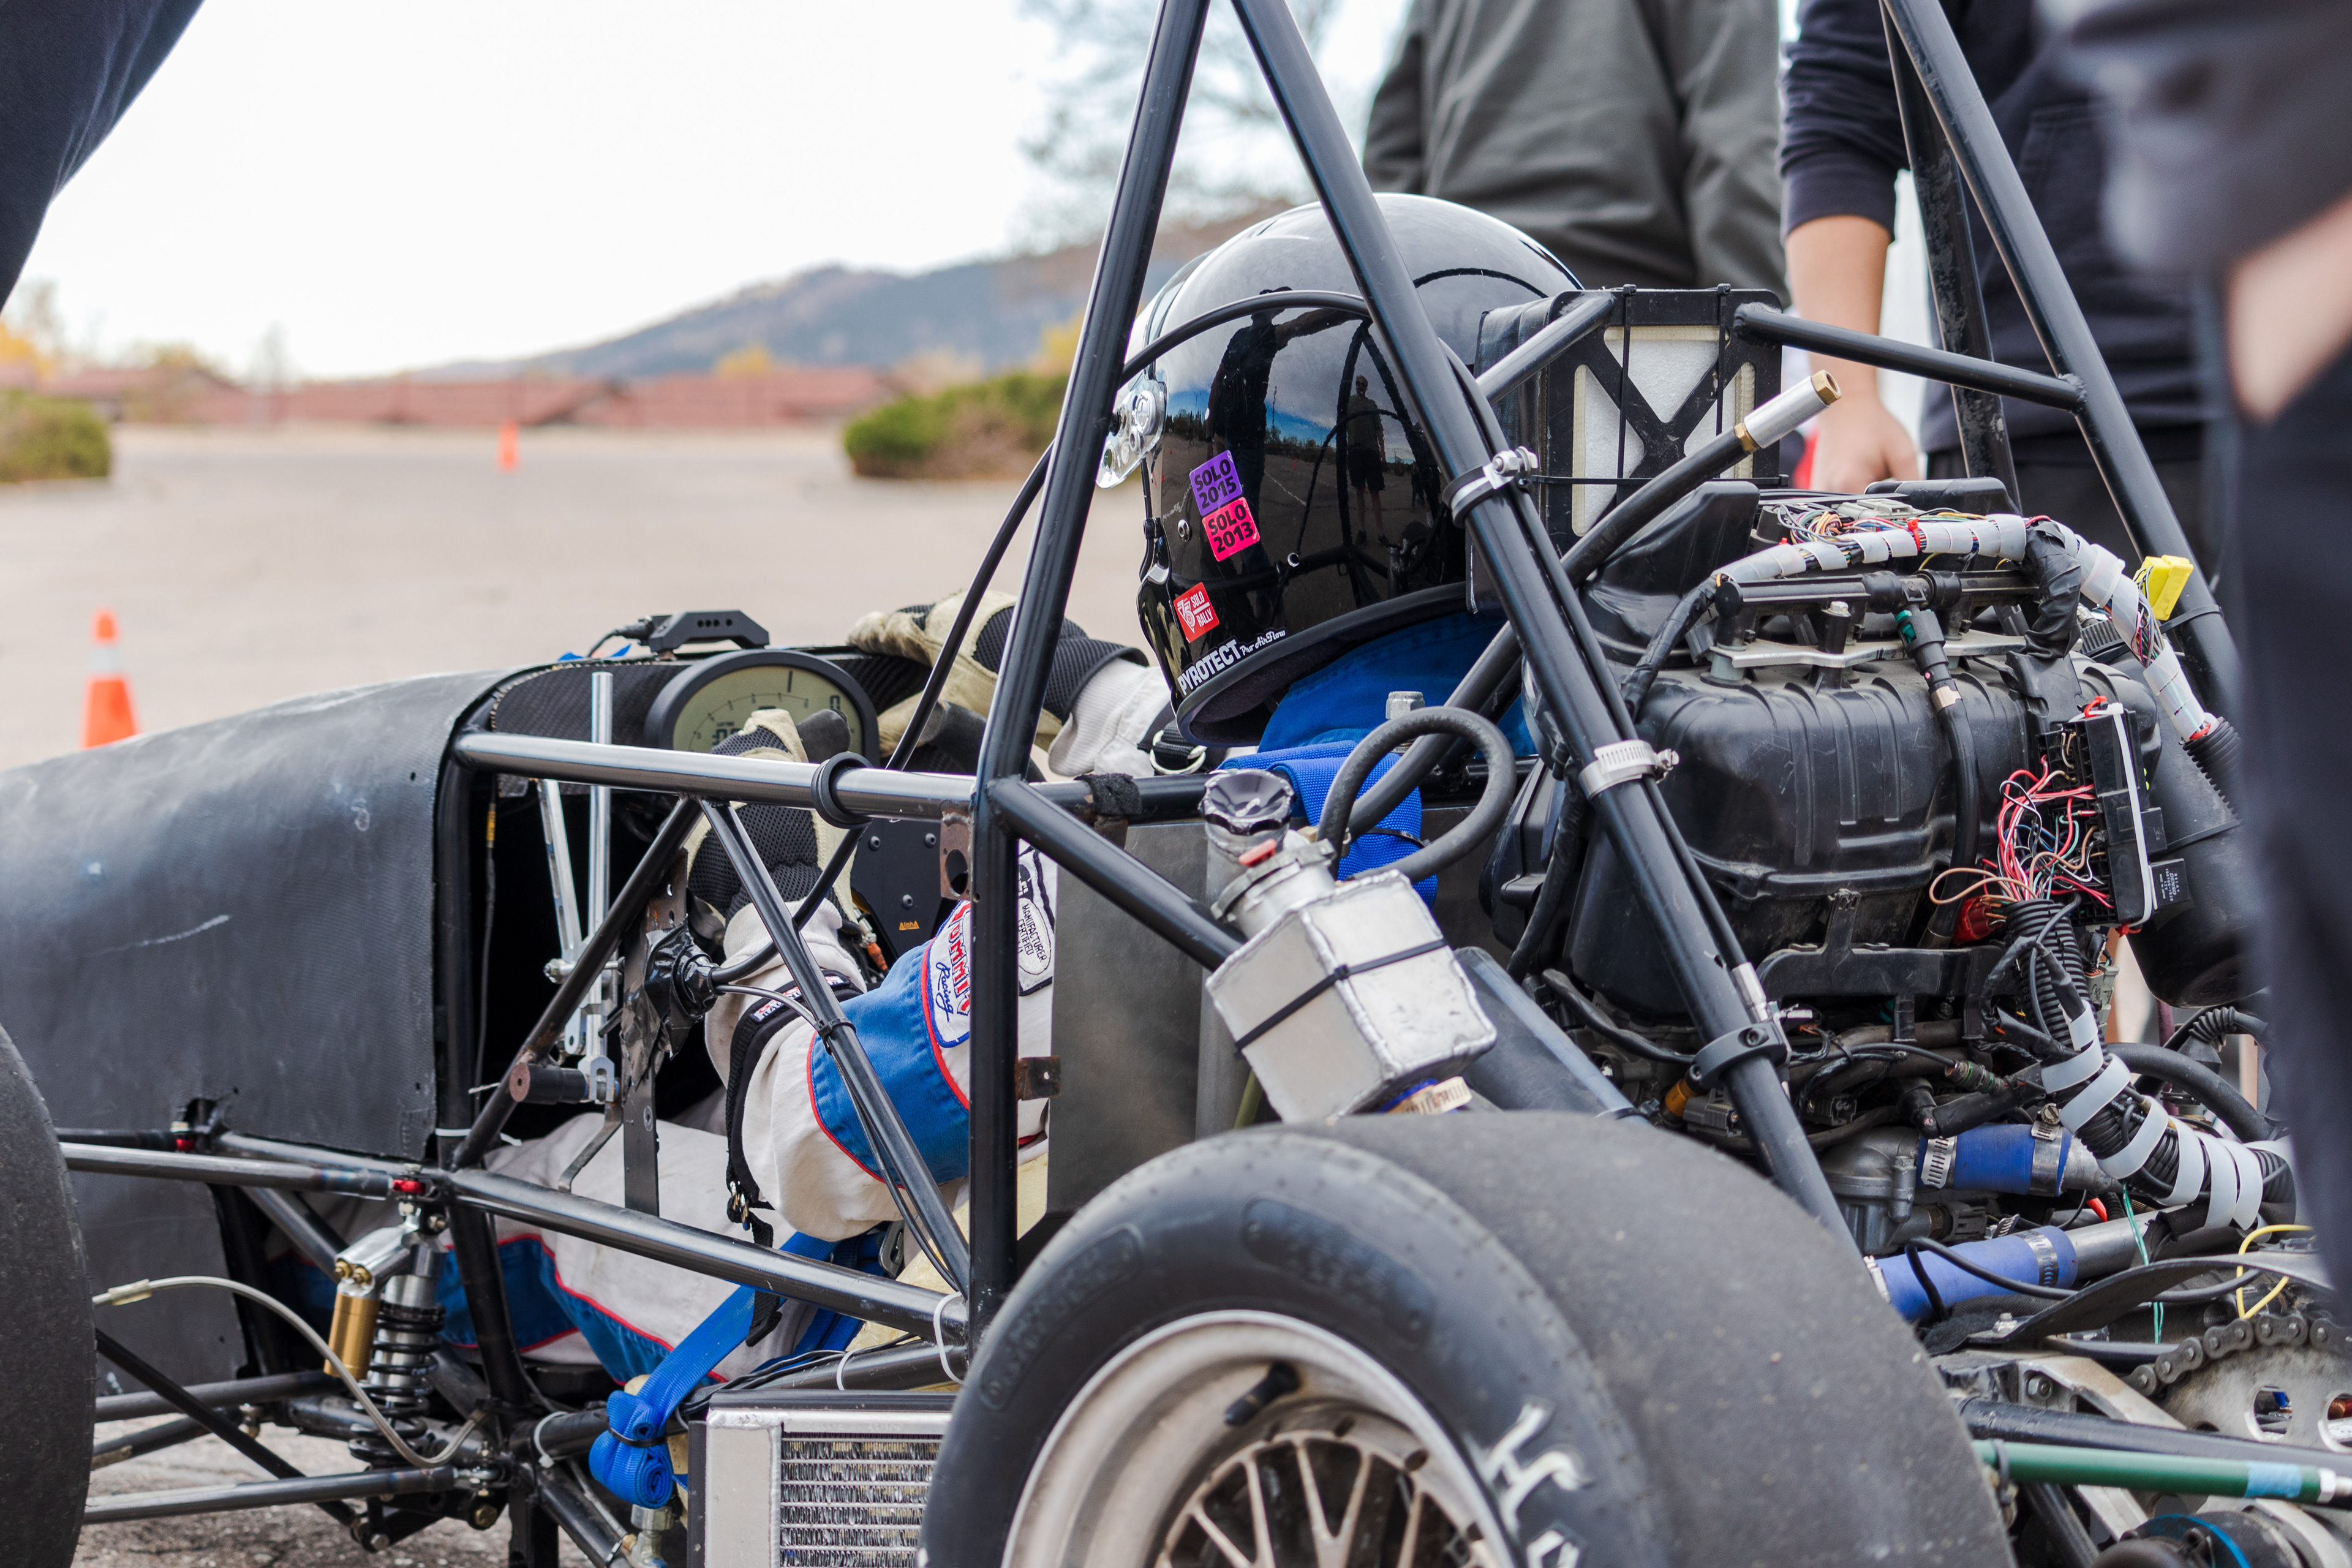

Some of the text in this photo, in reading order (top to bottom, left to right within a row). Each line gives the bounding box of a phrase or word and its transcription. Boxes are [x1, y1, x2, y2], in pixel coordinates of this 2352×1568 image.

[1194, 459, 1231, 492] SOLO
[1199, 475, 1237, 509] 2015
[1208, 504, 1246, 536] SOLO
[1213, 521, 1254, 553] 2013
[1190, 591, 1205, 608] SOLO
[1196, 608, 1213, 627] RALLY
[1177, 639, 1241, 696] PYROTECT
[1240, 645, 1254, 656] Pro
[1022, 903, 1047, 963] MANUFACTURER
[936, 962, 954, 1023] Racing
